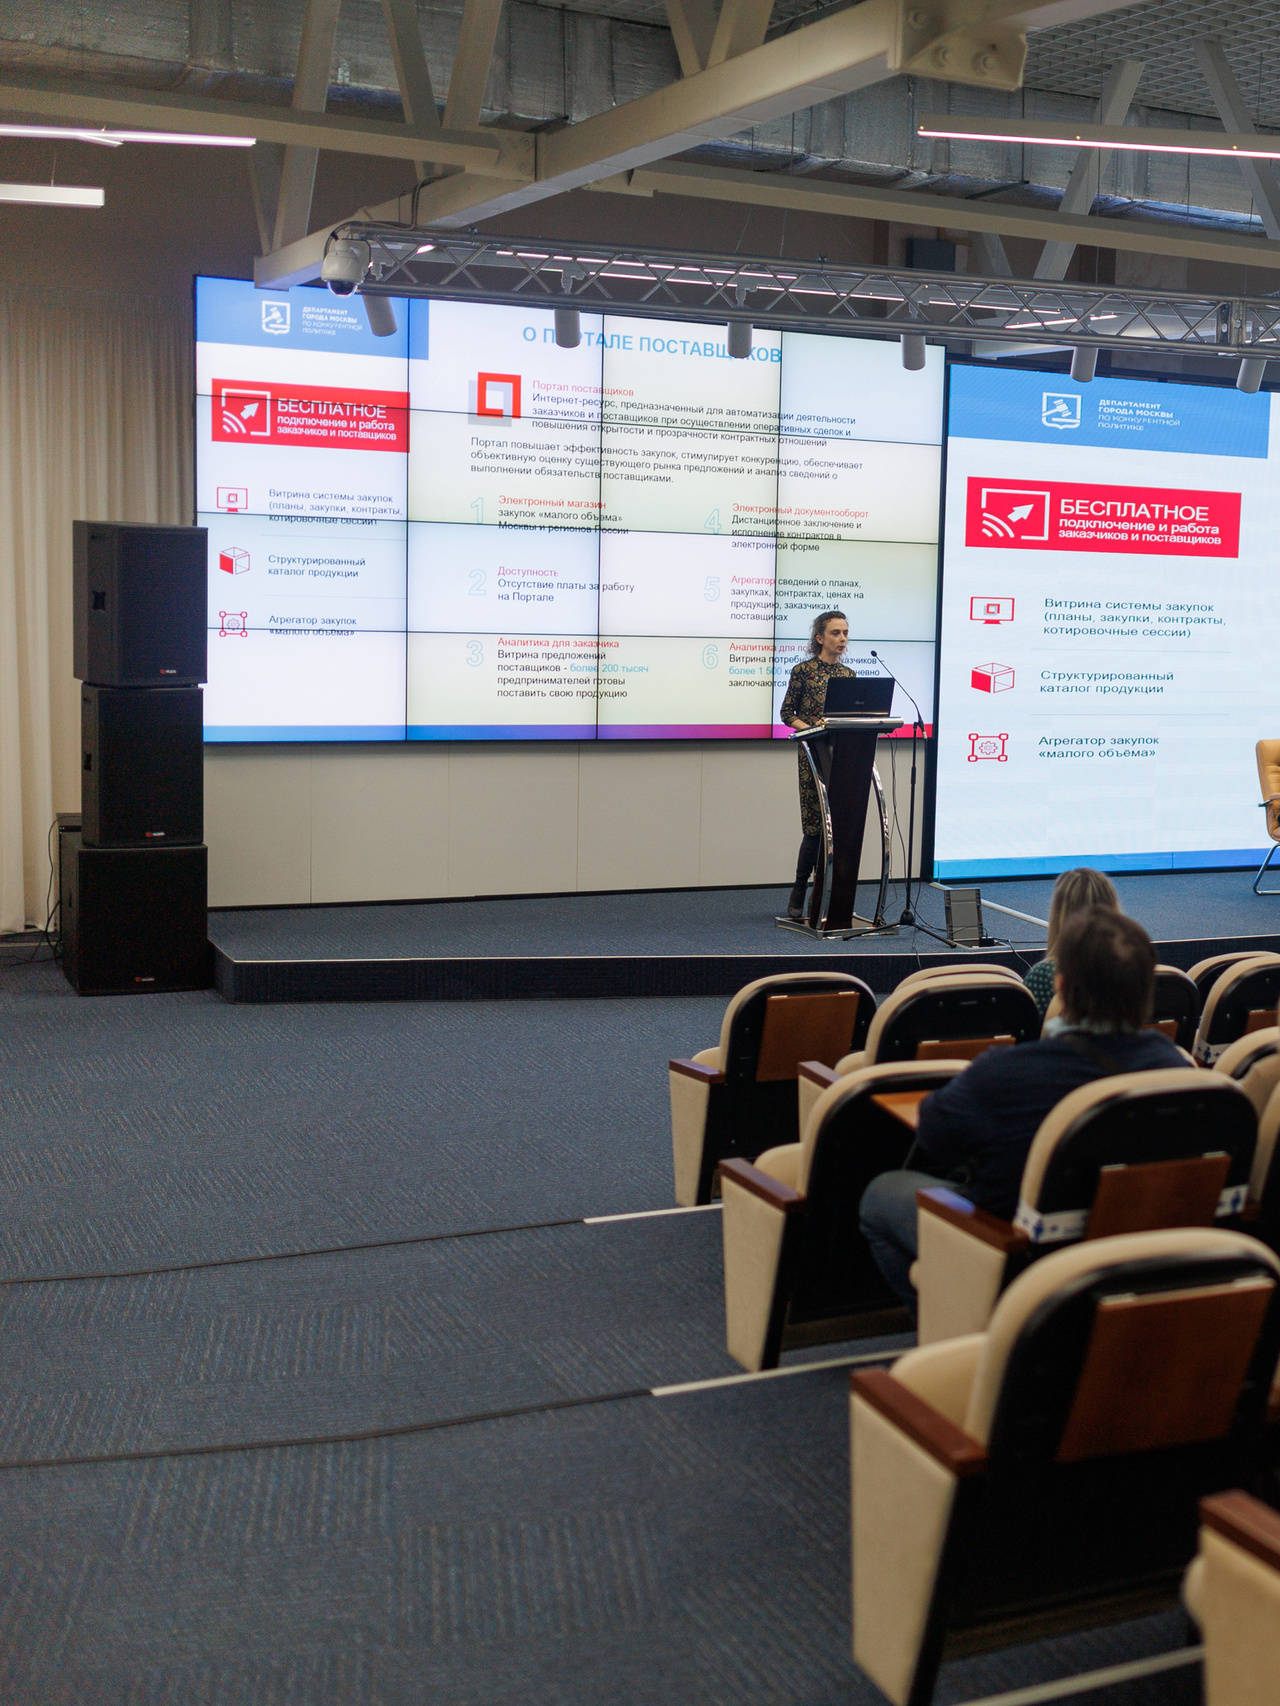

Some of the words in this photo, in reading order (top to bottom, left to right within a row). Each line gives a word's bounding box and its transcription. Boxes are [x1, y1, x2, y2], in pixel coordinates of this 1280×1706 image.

[522, 326, 537, 342] О
[543, 327, 633, 351] ПТАЛЕ
[532, 380, 568, 392] Портал
[571, 385, 634, 396] поставщиков
[278, 397, 386, 418] БЕСПЛАТНОЕ
[1098, 399, 1162, 410] ДЕПАРТАМЕНТ
[1098, 406, 1134, 415] ГОРОДА
[1136, 409, 1174, 418] МОСКВЫ
[277, 416, 348, 427] подключение
[349, 420, 356, 428] и
[358, 419, 394, 431] работа
[1112, 415, 1181, 426] КОНКУРЕНТНОЙ
[1098, 422, 1144, 431] ПОЛИТИКЕ
[277, 426, 328, 436] заказчиков
[337, 426, 396, 440] поставщиков
[268, 488, 310, 499] Витрина
[312, 492, 354, 500] системы
[357, 494, 392, 502] закупок
[498, 497, 564, 507] Электронный
[567, 500, 606, 509] магазин
[1060, 498, 1209, 521] БЕСПЛАТНОЕ
[498, 509, 536, 518] закупок
[538, 511, 578, 520] «малого
[580, 511, 622, 522] объема»
[1059, 518, 1155, 531] подключение
[1158, 523, 1168, 532] и
[1170, 521, 1219, 536] работа
[1058, 526, 1128, 540] заказчиков
[1141, 529, 1221, 544] поставщиков
[731, 541, 788, 550] электронной
[789, 543, 820, 552] форме
[268, 555, 365, 566] Структурированный
[308, 569, 358, 578] продукции
[497, 566, 559, 577] Доступность
[497, 578, 554, 589] Отсутствие
[602, 582, 634, 593] работу
[512, 591, 554, 602] Портале
[1044, 598, 1101, 608] Витрина
[1105, 602, 1162, 610] системы
[1165, 603, 1213, 612] закупок
[268, 615, 318, 625] Агрегатор
[1044, 611, 1096, 623] (планы,
[1100, 614, 1154, 624] закупки,
[1157, 616, 1226, 626] контракты,
[1043, 627, 1138, 635] котировочные
[1142, 629, 1190, 639] сессии)
[497, 638, 550, 646] Аналитика
[551, 640, 570, 648] для
[728, 642, 776, 652] Аналитика
[778, 644, 795, 653] для
[497, 649, 539, 659] Витрина
[541, 652, 606, 660] предложений
[729, 654, 767, 664] Витрина
[1040, 670, 1174, 681] Структурированный
[728, 680, 787, 688] заключаются
[1095, 685, 1163, 694] продукции
[1038, 736, 1106, 746] Агрегатор
[1110, 737, 1158, 745] закупок
[1038, 750, 1094, 758] «малого
[1098, 749, 1155, 757] объёма»
